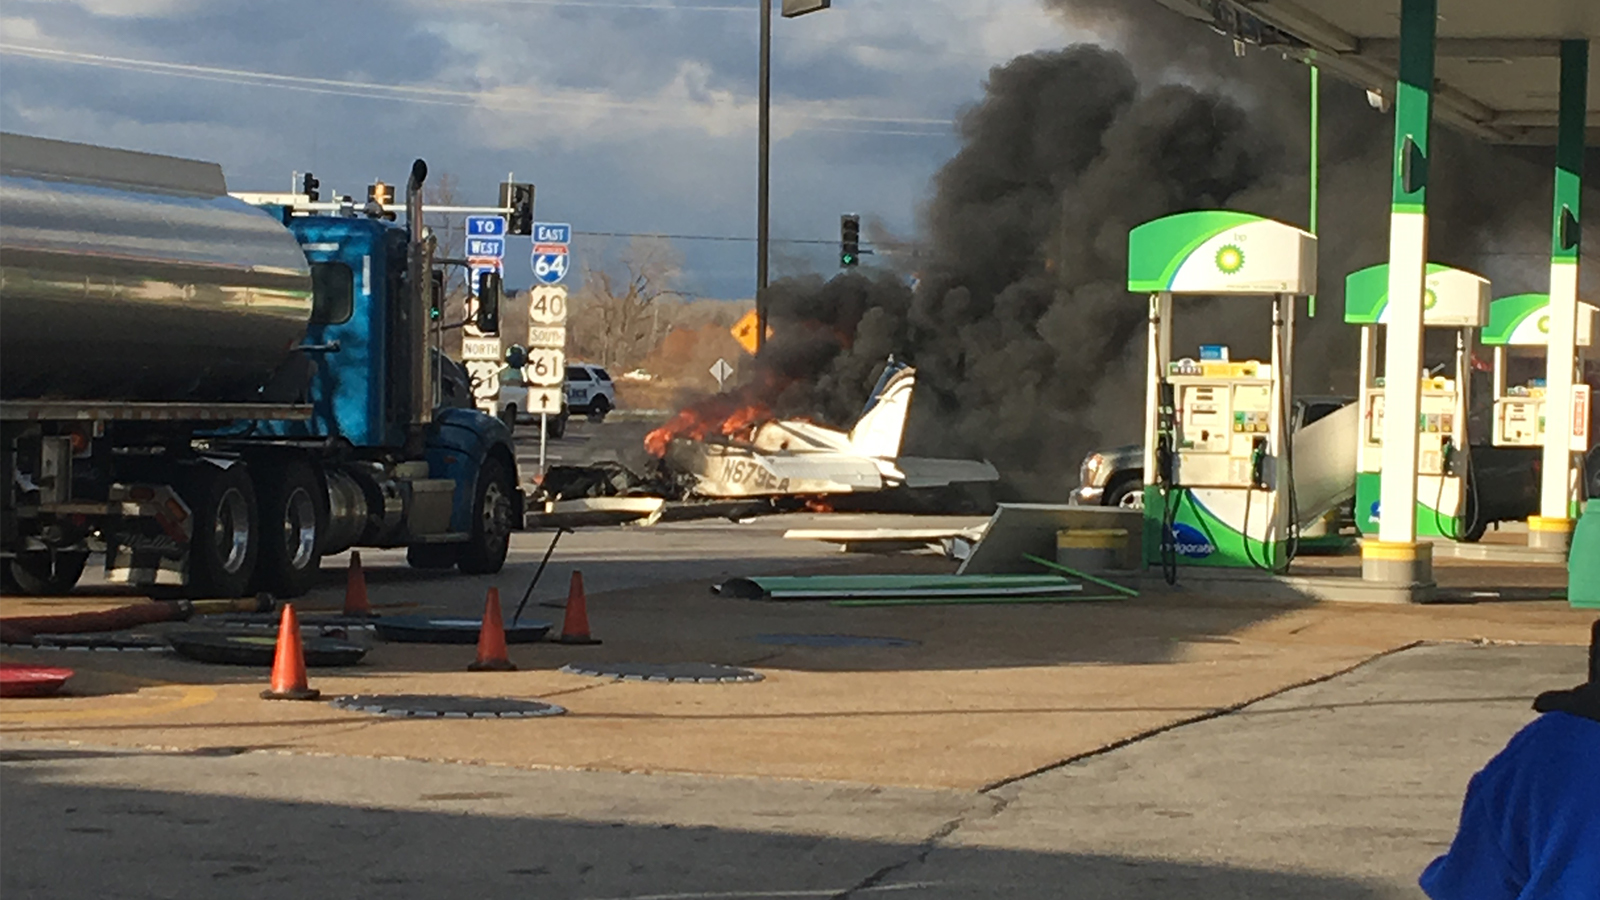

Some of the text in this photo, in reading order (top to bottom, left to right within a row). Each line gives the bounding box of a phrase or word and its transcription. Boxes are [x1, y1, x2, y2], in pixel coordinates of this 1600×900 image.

[476, 220, 495, 233] TO
[538, 227, 564, 240] EAST
[471, 240, 499, 254] WEST
[535, 255, 564, 276] 64
[534, 294, 563, 316] 40
[531, 329, 561, 343] SOUTH
[464, 343, 498, 355] NORTH
[535, 356, 558, 377] 61
[721, 458, 790, 493] N679EA
